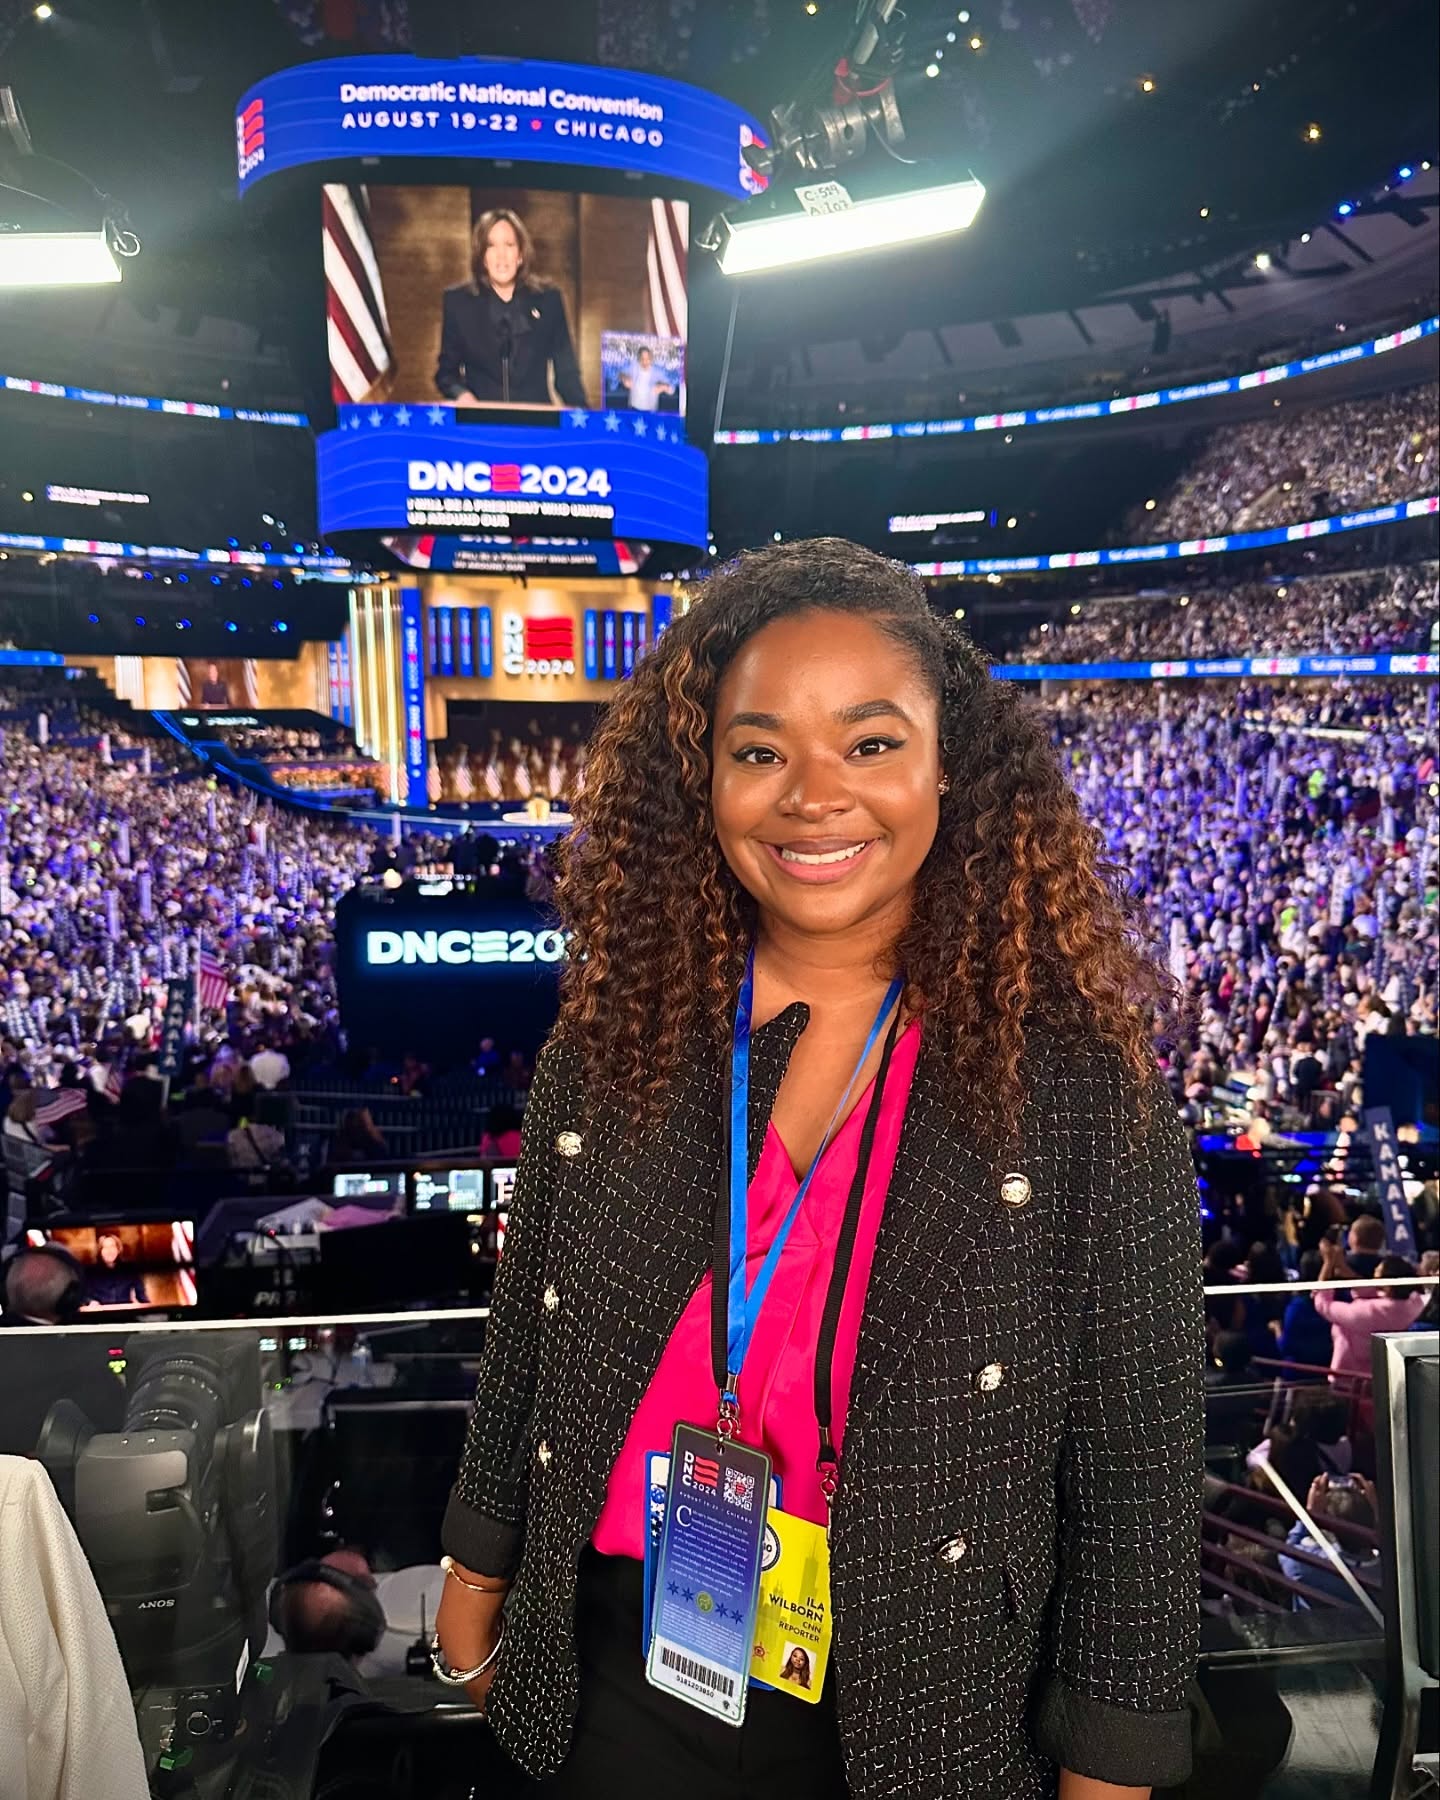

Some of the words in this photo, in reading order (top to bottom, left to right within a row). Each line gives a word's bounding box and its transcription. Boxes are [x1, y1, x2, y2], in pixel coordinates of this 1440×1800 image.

[340, 81, 456, 103] Democratic
[459, 83, 547, 108] National
[549, 88, 664, 122] Convention
[341, 111, 440, 129] AUGUST
[450, 112, 518, 132] 19-22
[554, 118, 664, 148] CHICAGO
[407, 461, 491, 493] DNC
[519, 466, 611, 497] 2024
[367, 930, 472, 964] DNC
[509, 930, 589, 963] 20
[1373, 1122, 1409, 1241] KAMALA
[682, 1450, 695, 1487] DNC
[692, 1481, 717, 1497] 2024
[769, 1593, 823, 1623] WILBORN
[806, 1596, 825, 1612] ILA
[779, 1620, 820, 1643] REPORTER
[802, 1620, 822, 1633] CNN
